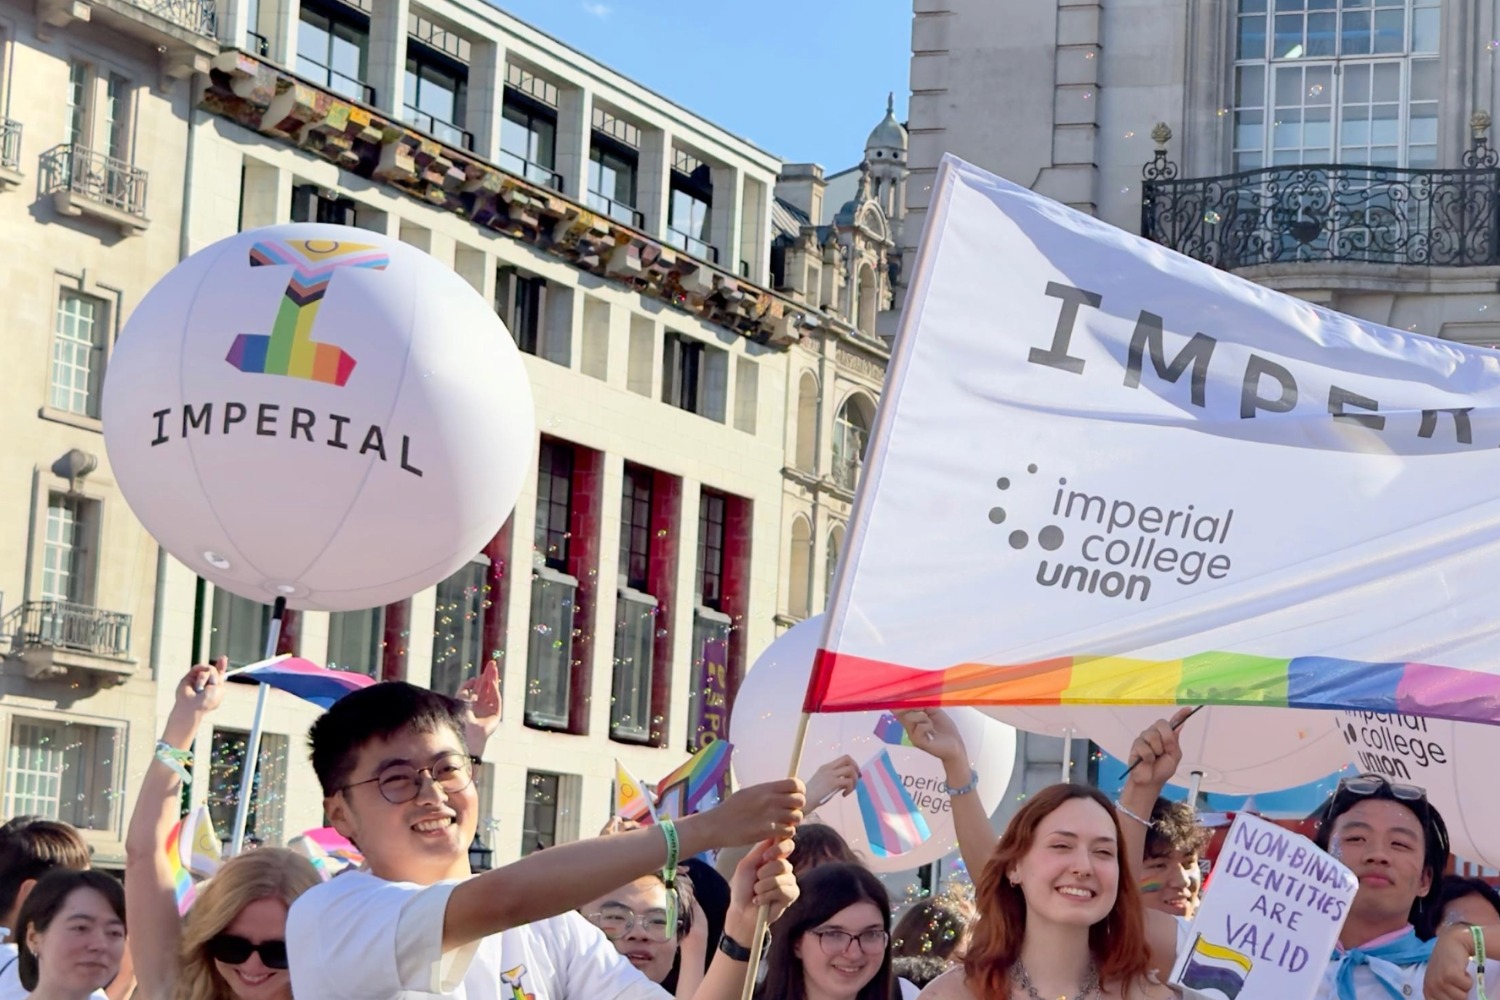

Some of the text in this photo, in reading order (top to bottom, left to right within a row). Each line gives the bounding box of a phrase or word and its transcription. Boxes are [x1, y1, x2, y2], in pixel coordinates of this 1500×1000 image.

[151, 401, 425, 478] IMPERIAL
[1053, 477, 1234, 545] imperial
[1036, 559, 1151, 602] union
[1081, 532, 1232, 586] college
[1357, 749, 1411, 780] union
[1361, 726, 1447, 767] college
[897, 774, 947, 794] peria
[908, 790, 952, 815] llege
[1235, 821, 1353, 893] NON-BINAR
[1225, 851, 1346, 922] IDENTITIES
[1250, 895, 1303, 931] ARE
[1226, 914, 1309, 973] VALID
